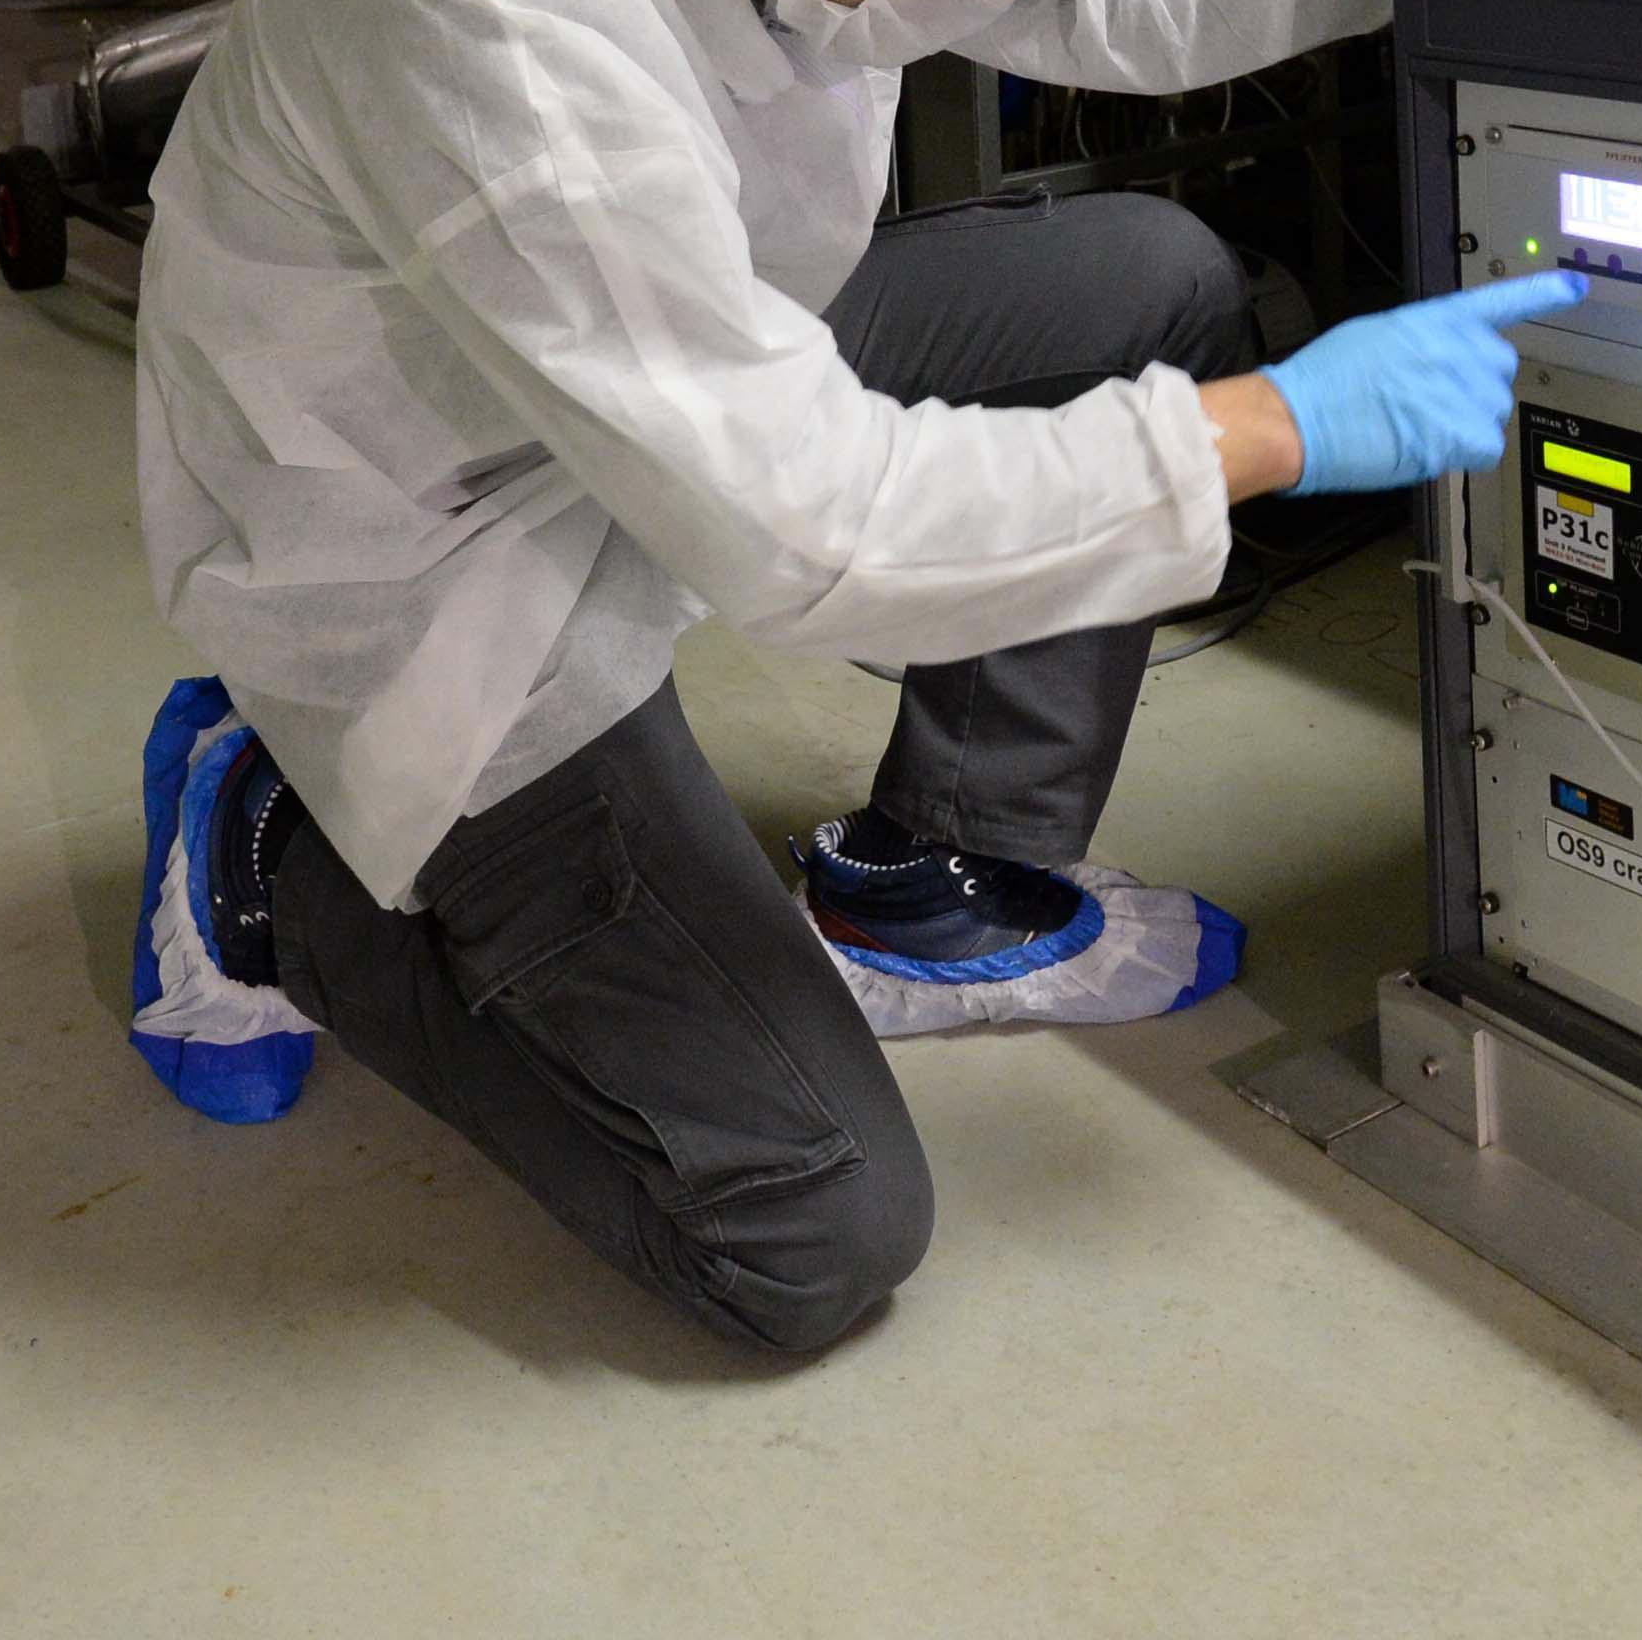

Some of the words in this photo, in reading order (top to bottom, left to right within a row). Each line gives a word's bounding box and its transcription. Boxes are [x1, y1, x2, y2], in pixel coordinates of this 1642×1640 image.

[1530, 413, 1562, 429] VARIAN
[1543, 507, 1609, 550] P31c
[1557, 831, 1605, 867] OS9
